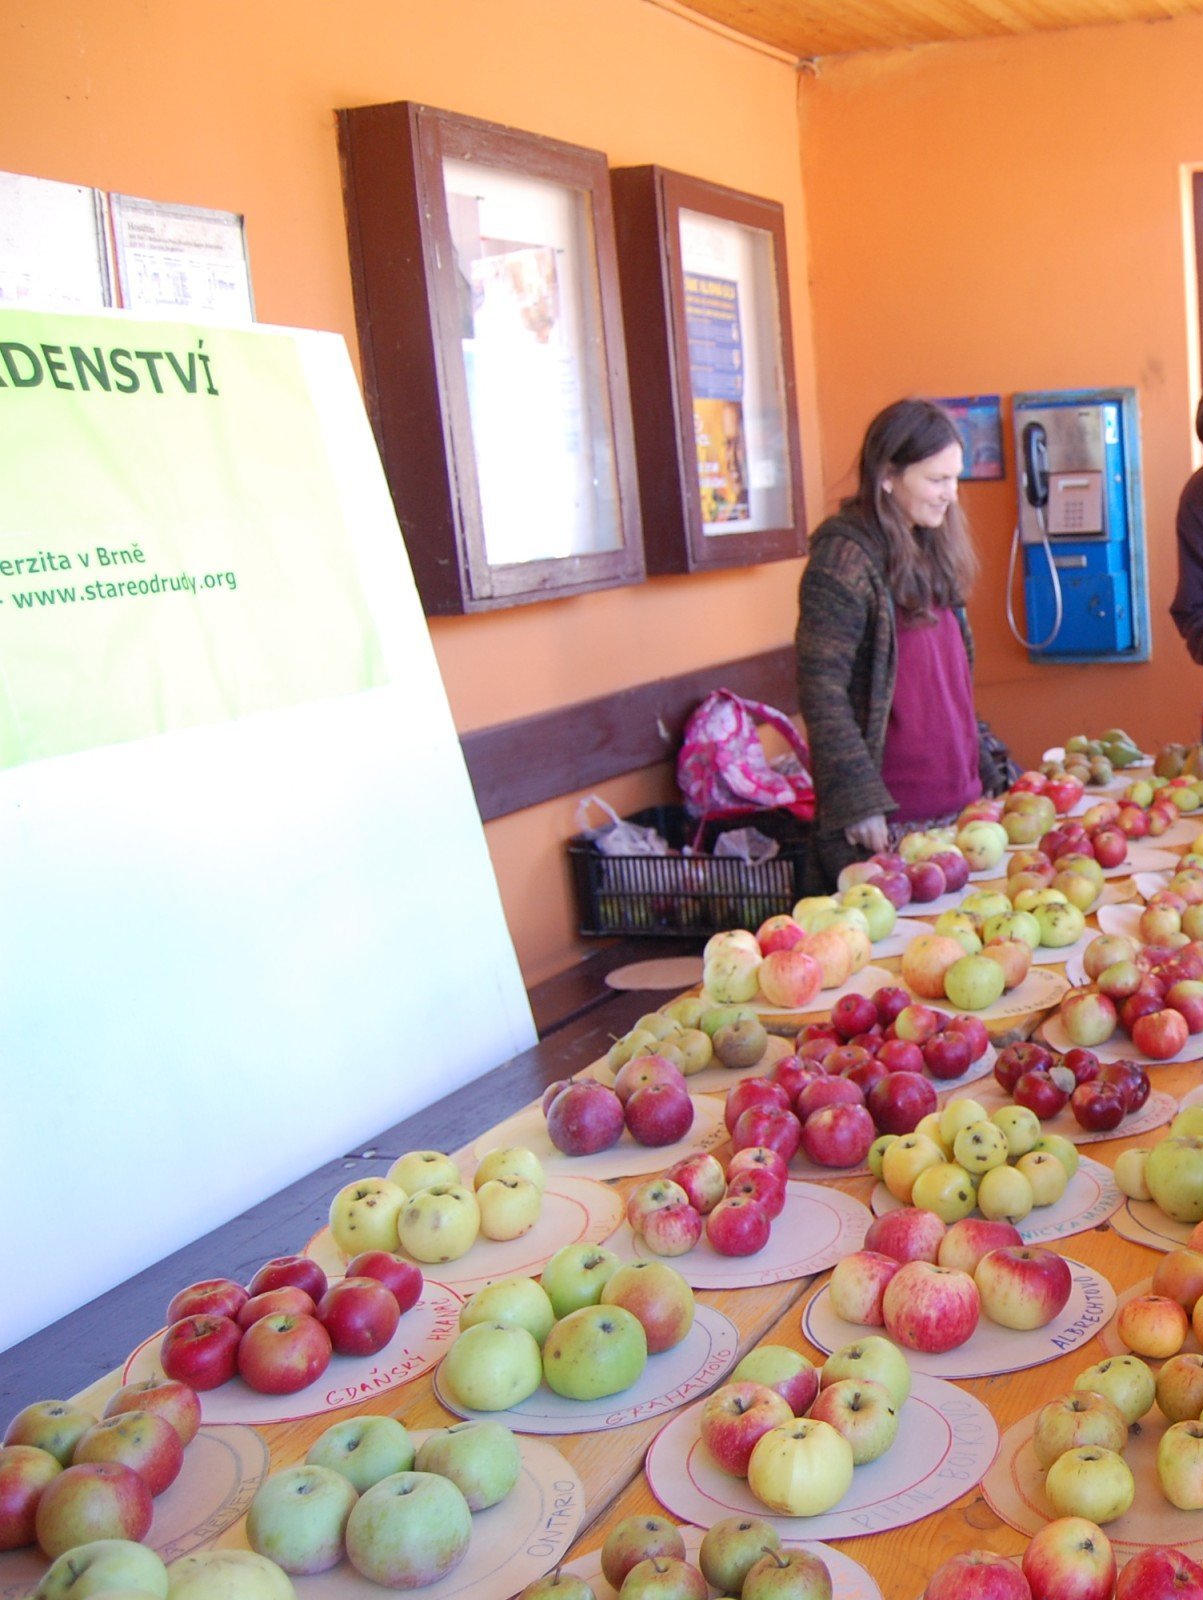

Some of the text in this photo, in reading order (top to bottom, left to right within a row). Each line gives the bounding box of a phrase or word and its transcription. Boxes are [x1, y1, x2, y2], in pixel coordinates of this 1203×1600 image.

[0, 339, 219, 396] DENSTVÍ
[77, 552, 89, 568] v
[96, 543, 146, 567] Brně
[12, 571, 237, 609] www.stareodrudy.org
[1050, 1276, 1104, 1350] ALBRECHTOVO
[606, 1349, 731, 1425] GRAHAMOVO
[527, 1480, 576, 1557] ONTARIO
